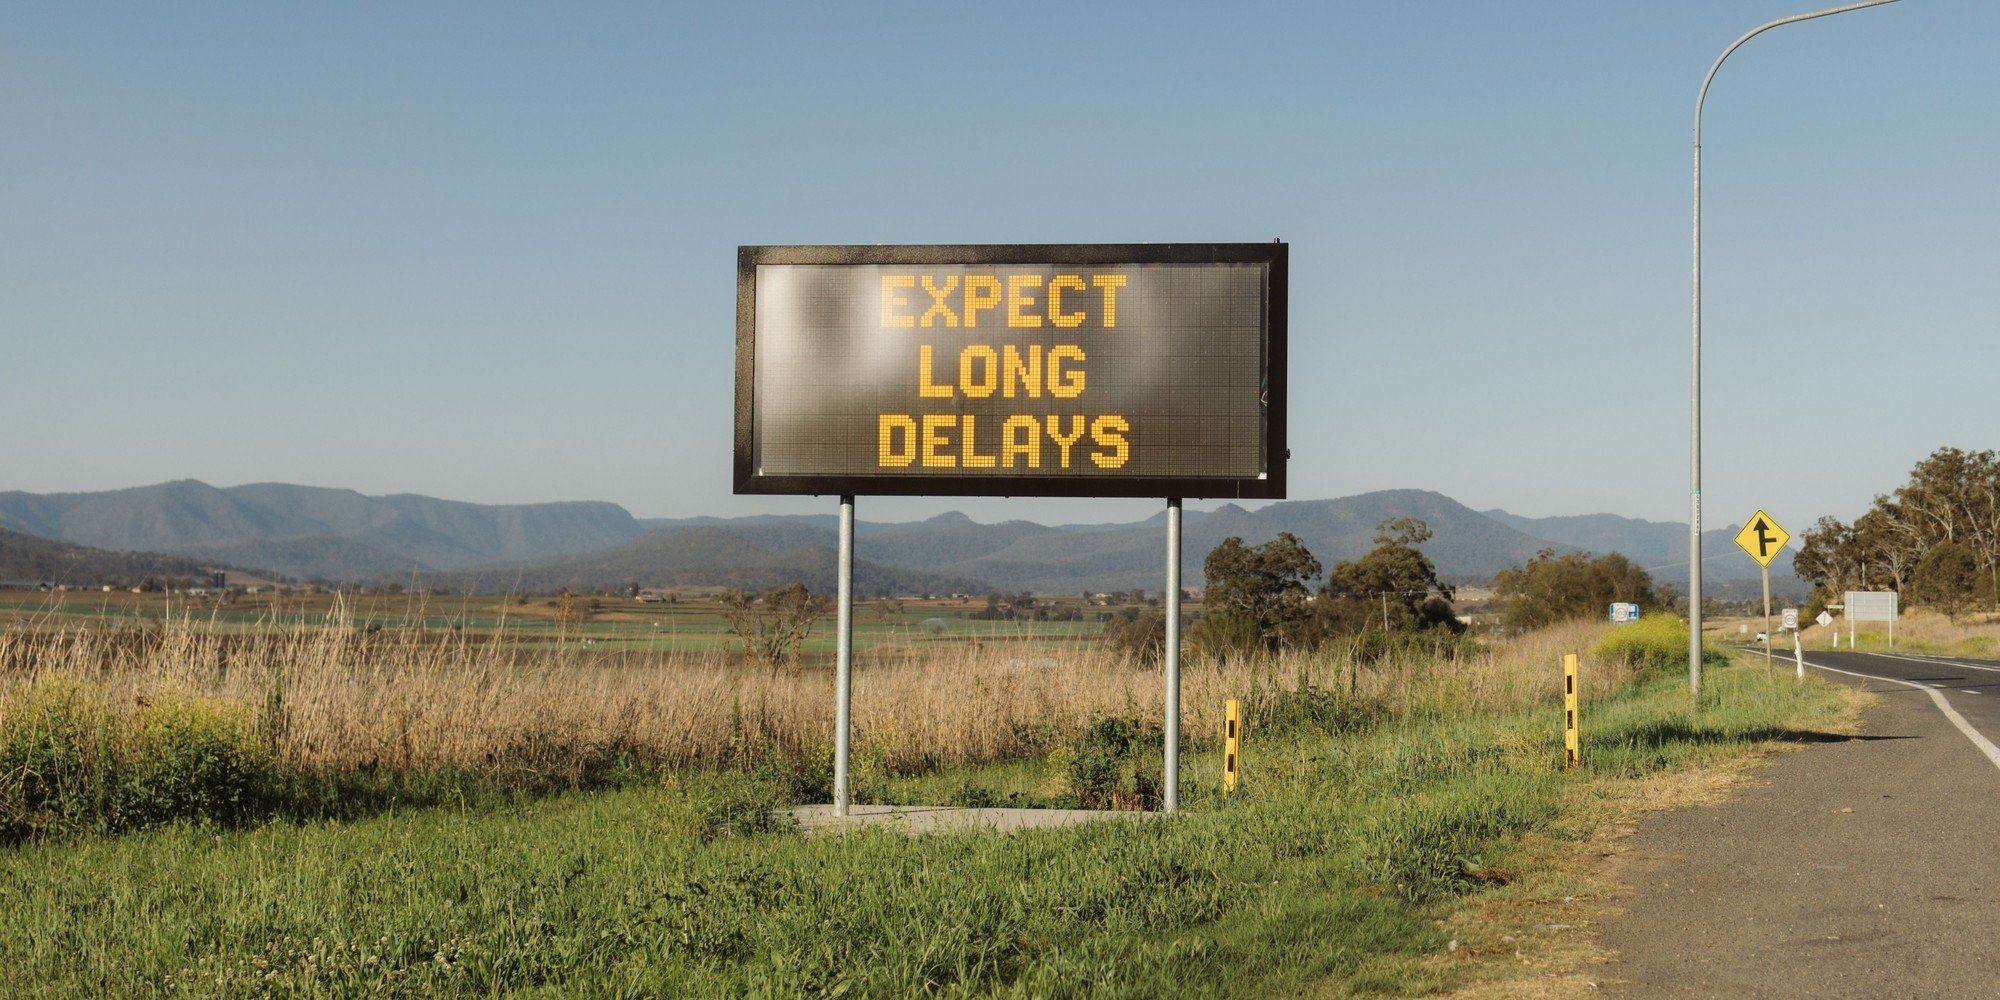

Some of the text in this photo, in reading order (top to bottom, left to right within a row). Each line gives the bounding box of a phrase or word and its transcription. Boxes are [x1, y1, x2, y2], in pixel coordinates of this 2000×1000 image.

[880, 274, 1127, 328] EXPECT
[919, 344, 1086, 398] LONG
[878, 414, 1129, 468] DELAYS
